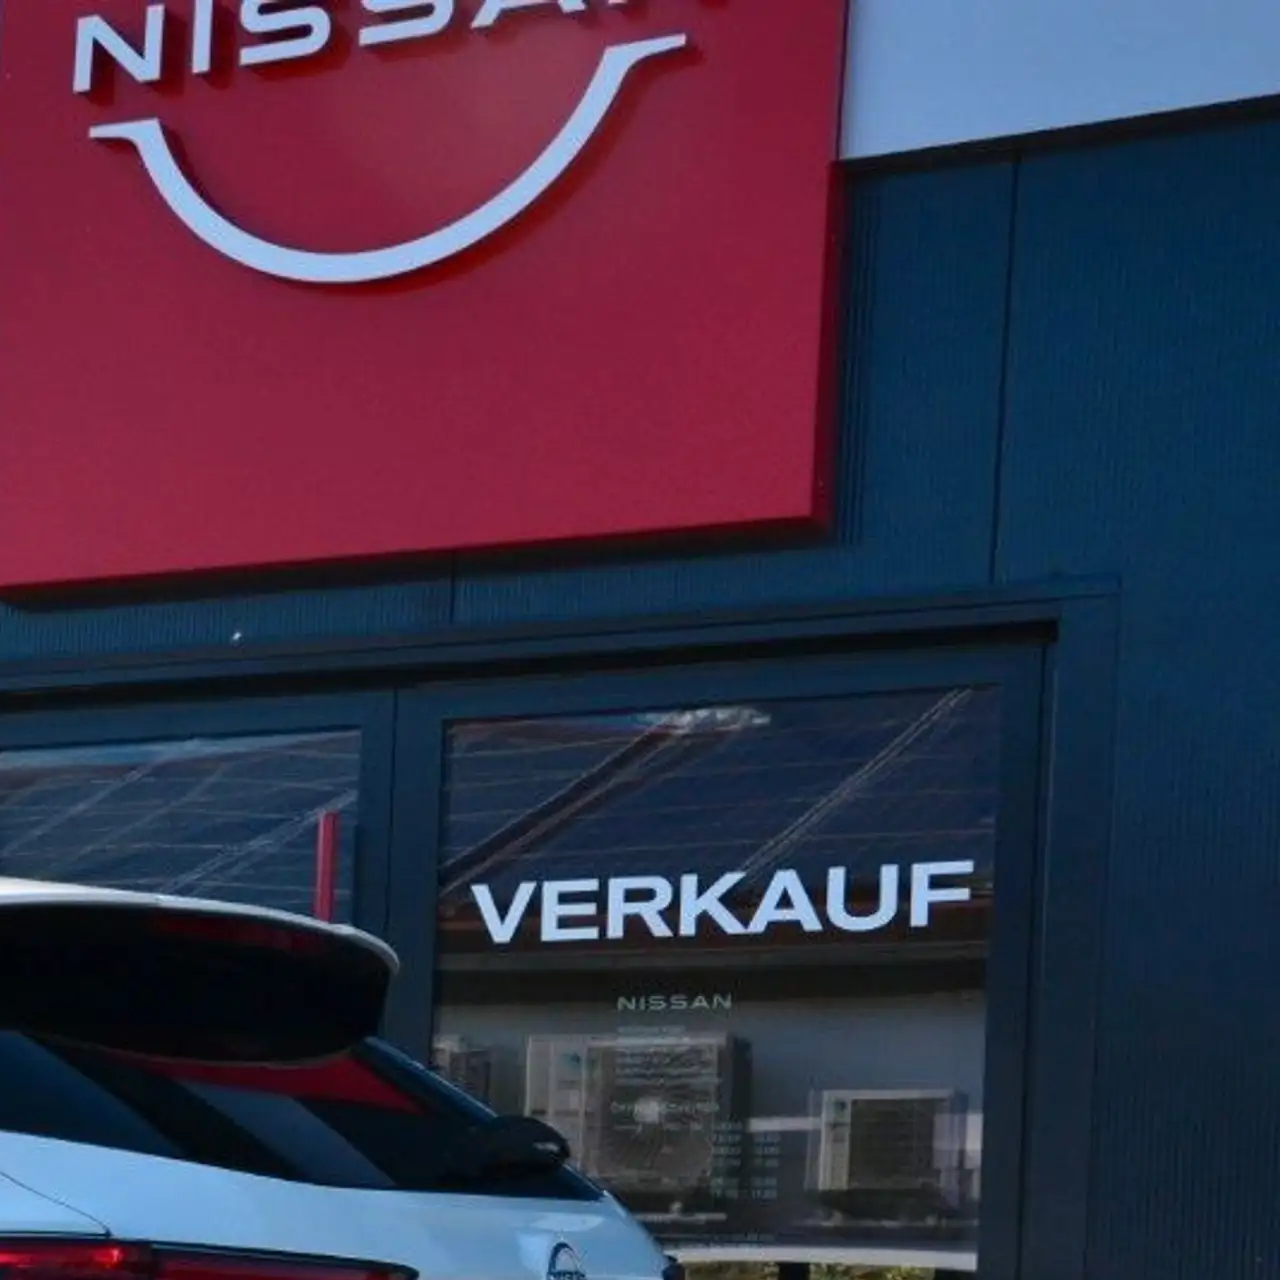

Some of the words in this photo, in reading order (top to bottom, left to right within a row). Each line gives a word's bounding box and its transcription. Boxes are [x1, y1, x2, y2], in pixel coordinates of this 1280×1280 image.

[73, 0, 630, 92] NISS
[471, 860, 975, 943] VERKAUF
[617, 993, 732, 1011] NISSAN
